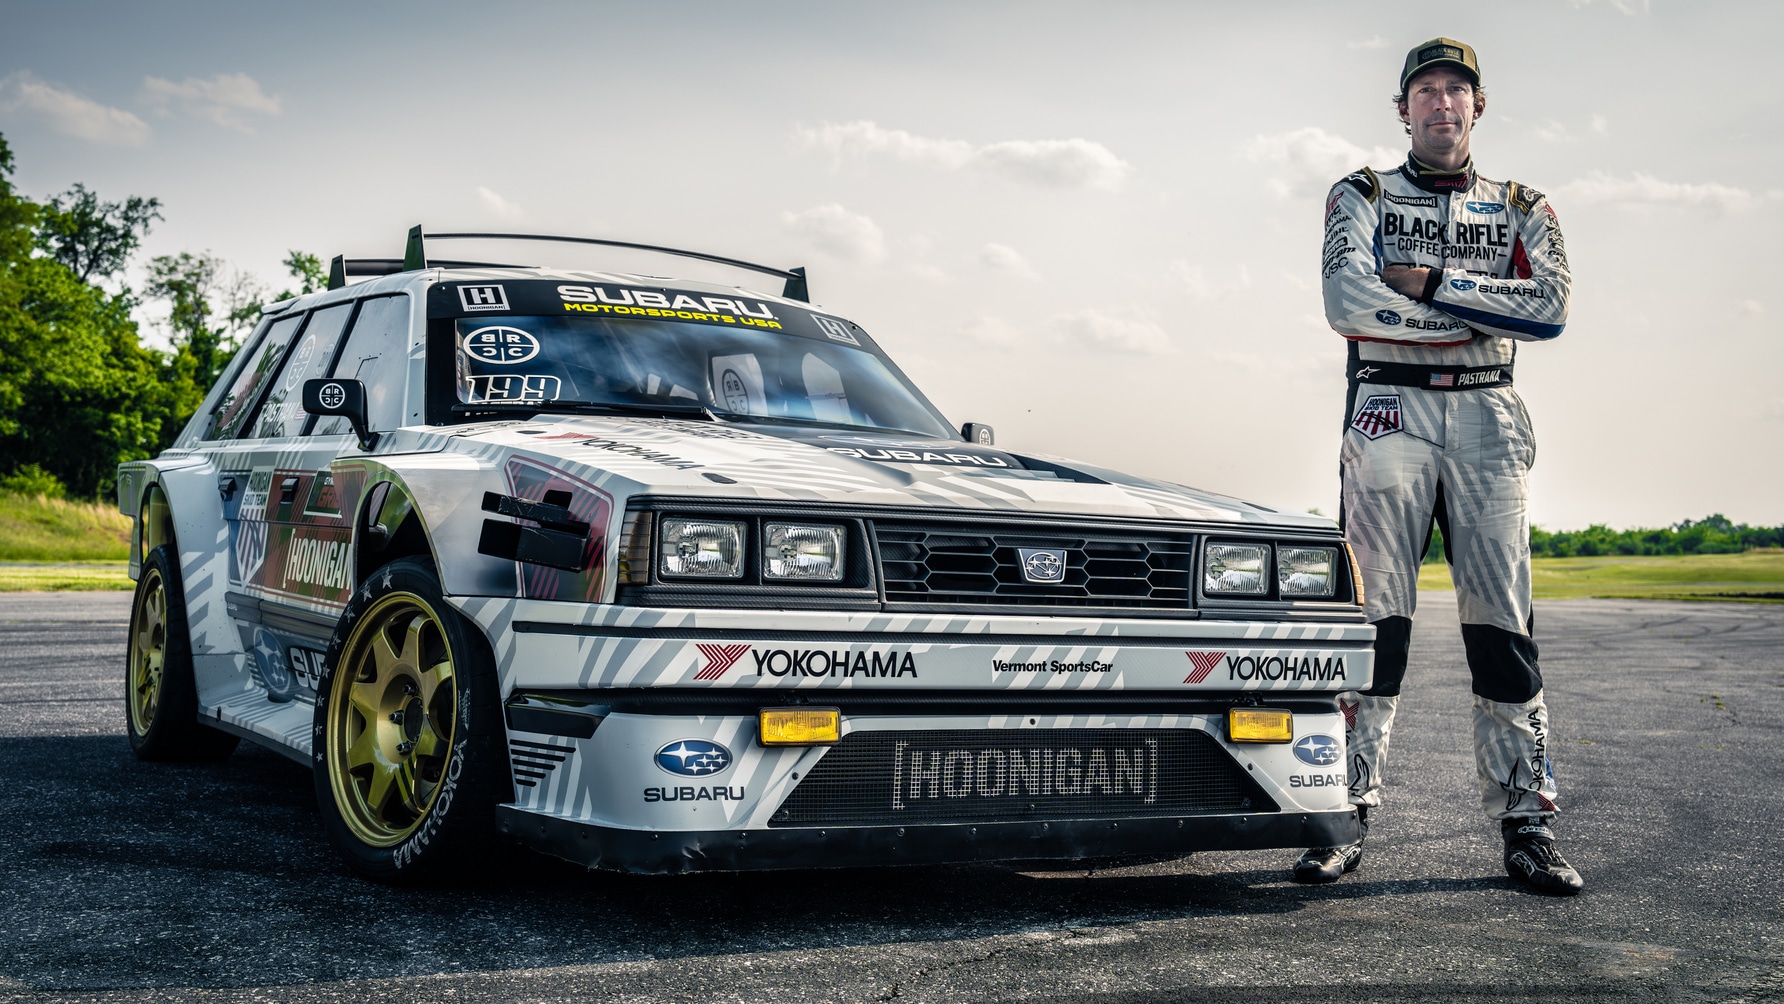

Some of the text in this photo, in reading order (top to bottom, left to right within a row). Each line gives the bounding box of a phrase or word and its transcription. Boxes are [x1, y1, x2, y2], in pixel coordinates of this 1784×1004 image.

[1384, 212, 1450, 245] BLACK
[1456, 221, 1508, 247] RIFLE
[1397, 237, 1498, 261] COFFEE COMPANY
[563, 303, 783, 330] MOTORSPORTS USA
[466, 374, 561, 404] 199
[1458, 370, 1501, 386] PASTRANA
[573, 438, 705, 470] YOKOHAMA
[752, 649, 918, 678] YOKOHAMA
[992, 659, 1113, 674] Vermont SportsCar
[1226, 656, 1346, 681] YOKOHAMA
[643, 786, 745, 803] SUBARU
